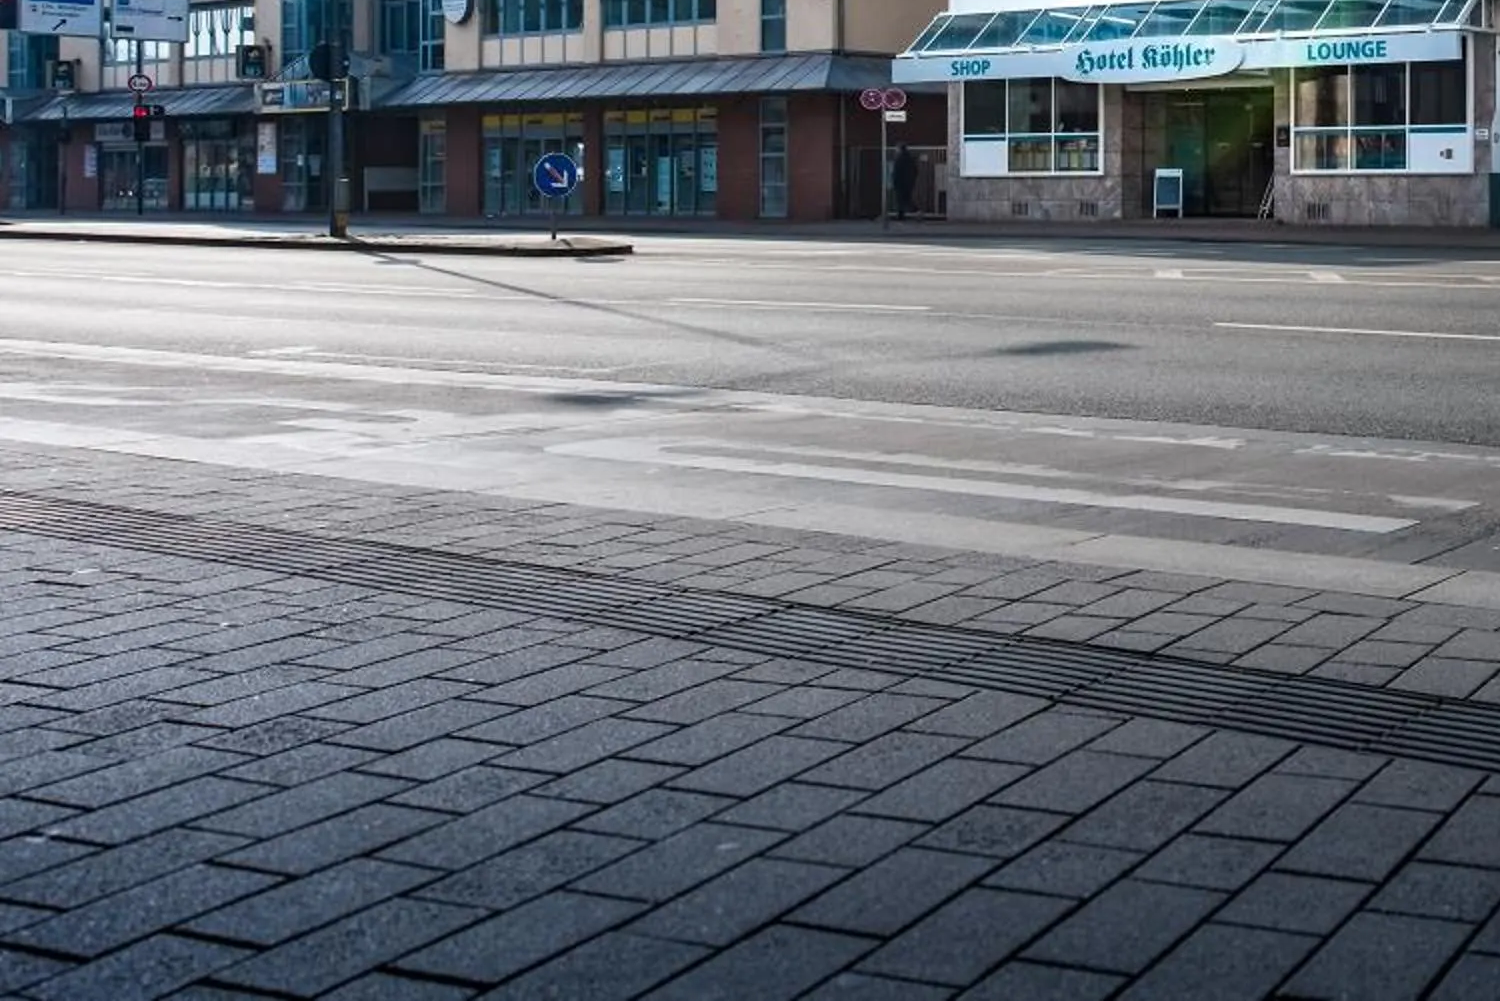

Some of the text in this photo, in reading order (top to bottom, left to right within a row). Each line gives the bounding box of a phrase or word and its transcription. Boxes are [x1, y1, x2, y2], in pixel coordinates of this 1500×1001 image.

[1075, 43, 1217, 75] Hotel Köhler
[1307, 40, 1388, 61] LOUNGE
[951, 59, 991, 77] SHOP
